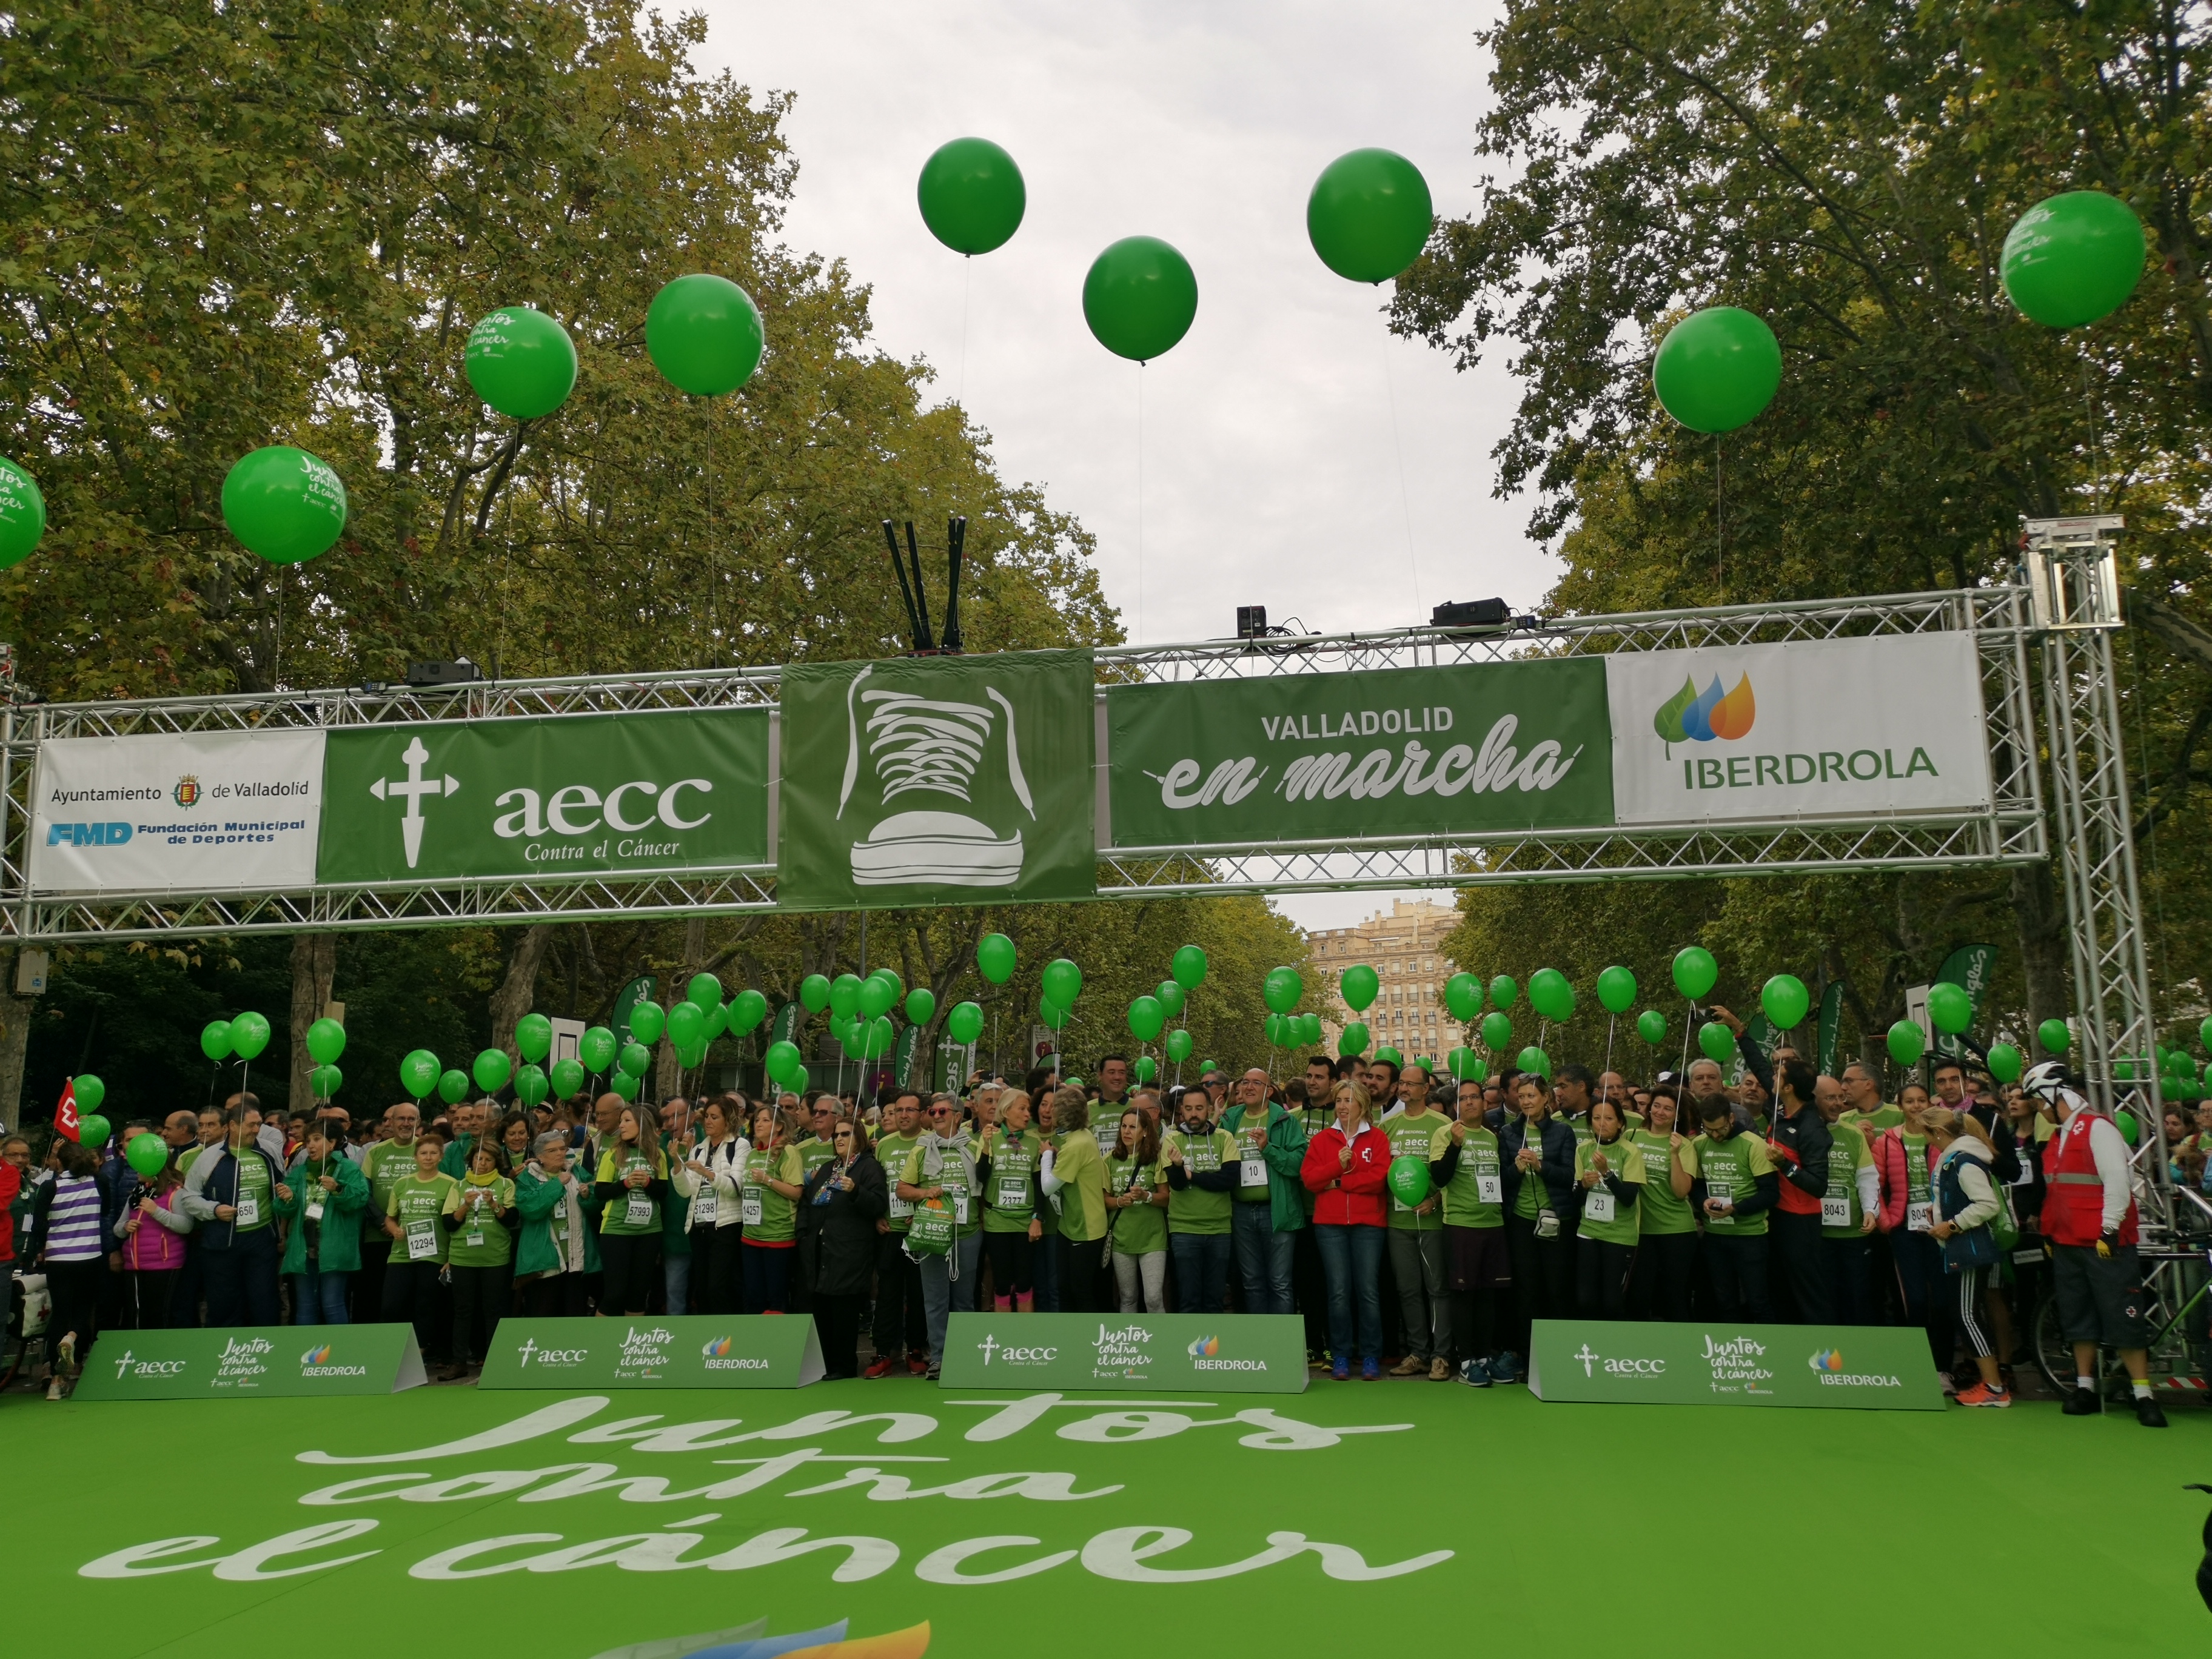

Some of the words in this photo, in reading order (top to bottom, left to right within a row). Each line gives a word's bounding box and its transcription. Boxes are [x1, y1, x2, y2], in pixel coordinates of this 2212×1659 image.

[1261, 706, 1453, 742] VALLADOLID
[1144, 756, 1268, 809] en
[1275, 714, 1583, 802] marcha
[1684, 747, 1939, 789] IBERDROLA
[52, 787, 161, 803] Ayuntamiento
[212, 785, 230, 798] de
[235, 781, 309, 797] Valladolid
[493, 779, 713, 837] aecc
[138, 822, 218, 834] Fundación
[224, 820, 304, 833] Municipal
[47, 822, 133, 847] FMD
[167, 835, 187, 845] de
[192, 832, 275, 845] Deportes
[525, 843, 583, 862] Contra
[592, 840, 607, 858] el
[617, 837, 679, 857] Cáncer
[1010, 1153, 1031, 1162] aecc
[1477, 1149, 1498, 1158] aecc
[1642, 1153, 1666, 1162] aecc
[1248, 1166, 1258, 1176] 10
[1714, 1162, 1737, 1171] aecc
[1486, 1182, 1493, 1193] 50
[629, 1206, 650, 1216] 57993
[743, 1205, 759, 1215] 14257
[1595, 1199, 1604, 1211] 23
[1824, 1204, 1845, 1216] 8043
[925, 1222, 949, 1232] aecc
[411, 1237, 434, 1250] 12294
[619, 1327, 675, 1348] Juntos
[1092, 1323, 1153, 1346] Juntos
[218, 1337, 274, 1358] Juntos
[623, 1342, 659, 1355] contra
[1099, 1341, 1139, 1354] contra
[1701, 1335, 1766, 1358] Juntos
[221, 1353, 258, 1365] contra
[538, 1349, 588, 1362] aecc
[1002, 1347, 1057, 1360] aecc
[1097, 1355, 1110, 1366] el
[1110, 1354, 1152, 1366] cáncer
[1711, 1353, 1755, 1367] contra
[135, 1361, 186, 1373] aecc
[620, 1355, 631, 1366] el
[632, 1355, 669, 1366] cáncer
[705, 1359, 768, 1369] IBERDROLA
[1195, 1359, 1267, 1370] IBERDROLA
[1604, 1358, 1666, 1373] aecc
[218, 1365, 228, 1375] el
[229, 1362, 268, 1375] cáncer
[302, 1366, 365, 1376] IBERDROLA
[1712, 1367, 1726, 1379] el
[1727, 1367, 1773, 1379] cáncer
[1820, 1374, 1902, 1387] IBERDROLA
[295, 1396, 1416, 1464] Juntos
[296, 1447, 1126, 1505] contra
[77, 1518, 383, 1582] el
[408, 1513, 1455, 1585] cáncer
